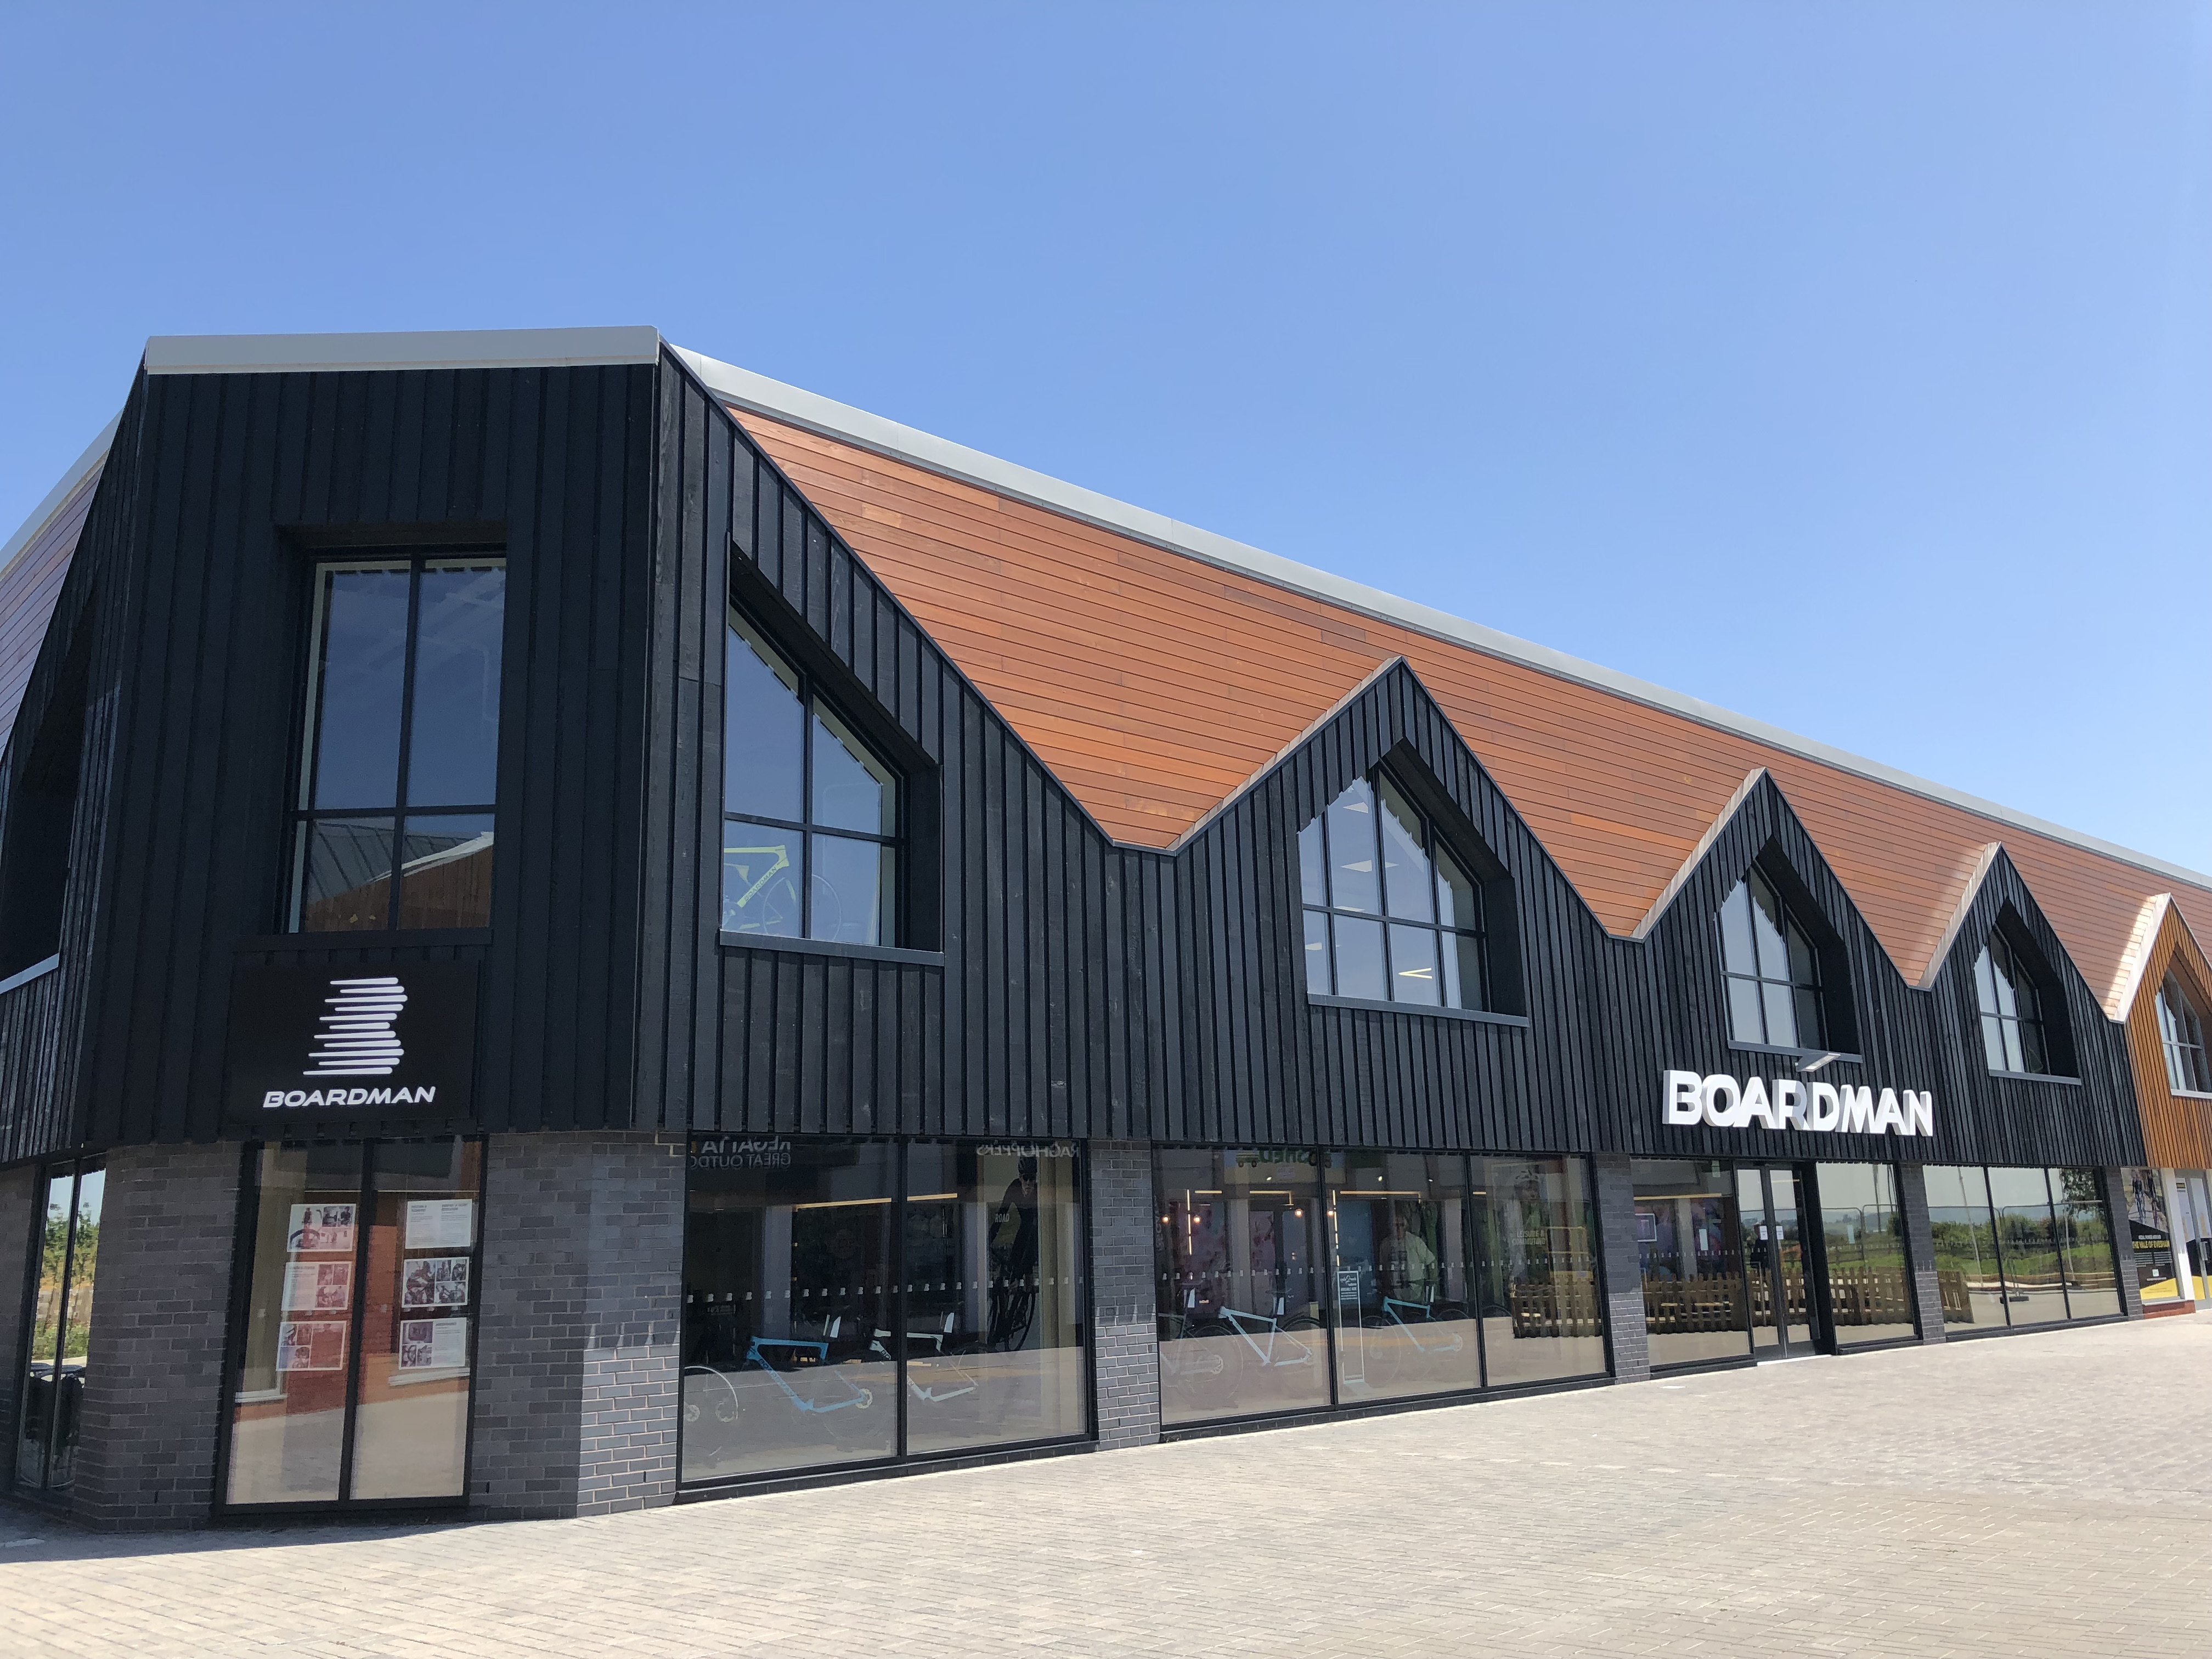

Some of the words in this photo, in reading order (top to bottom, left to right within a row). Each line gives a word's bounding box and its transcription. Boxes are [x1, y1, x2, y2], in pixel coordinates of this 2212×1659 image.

[744, 866, 777, 901] BOARDMAN
[262, 1086, 436, 1108] BOARDMAN
[1662, 1069, 1934, 1137] BOARDMAN
[995, 1213, 1010, 1223] ROAD
